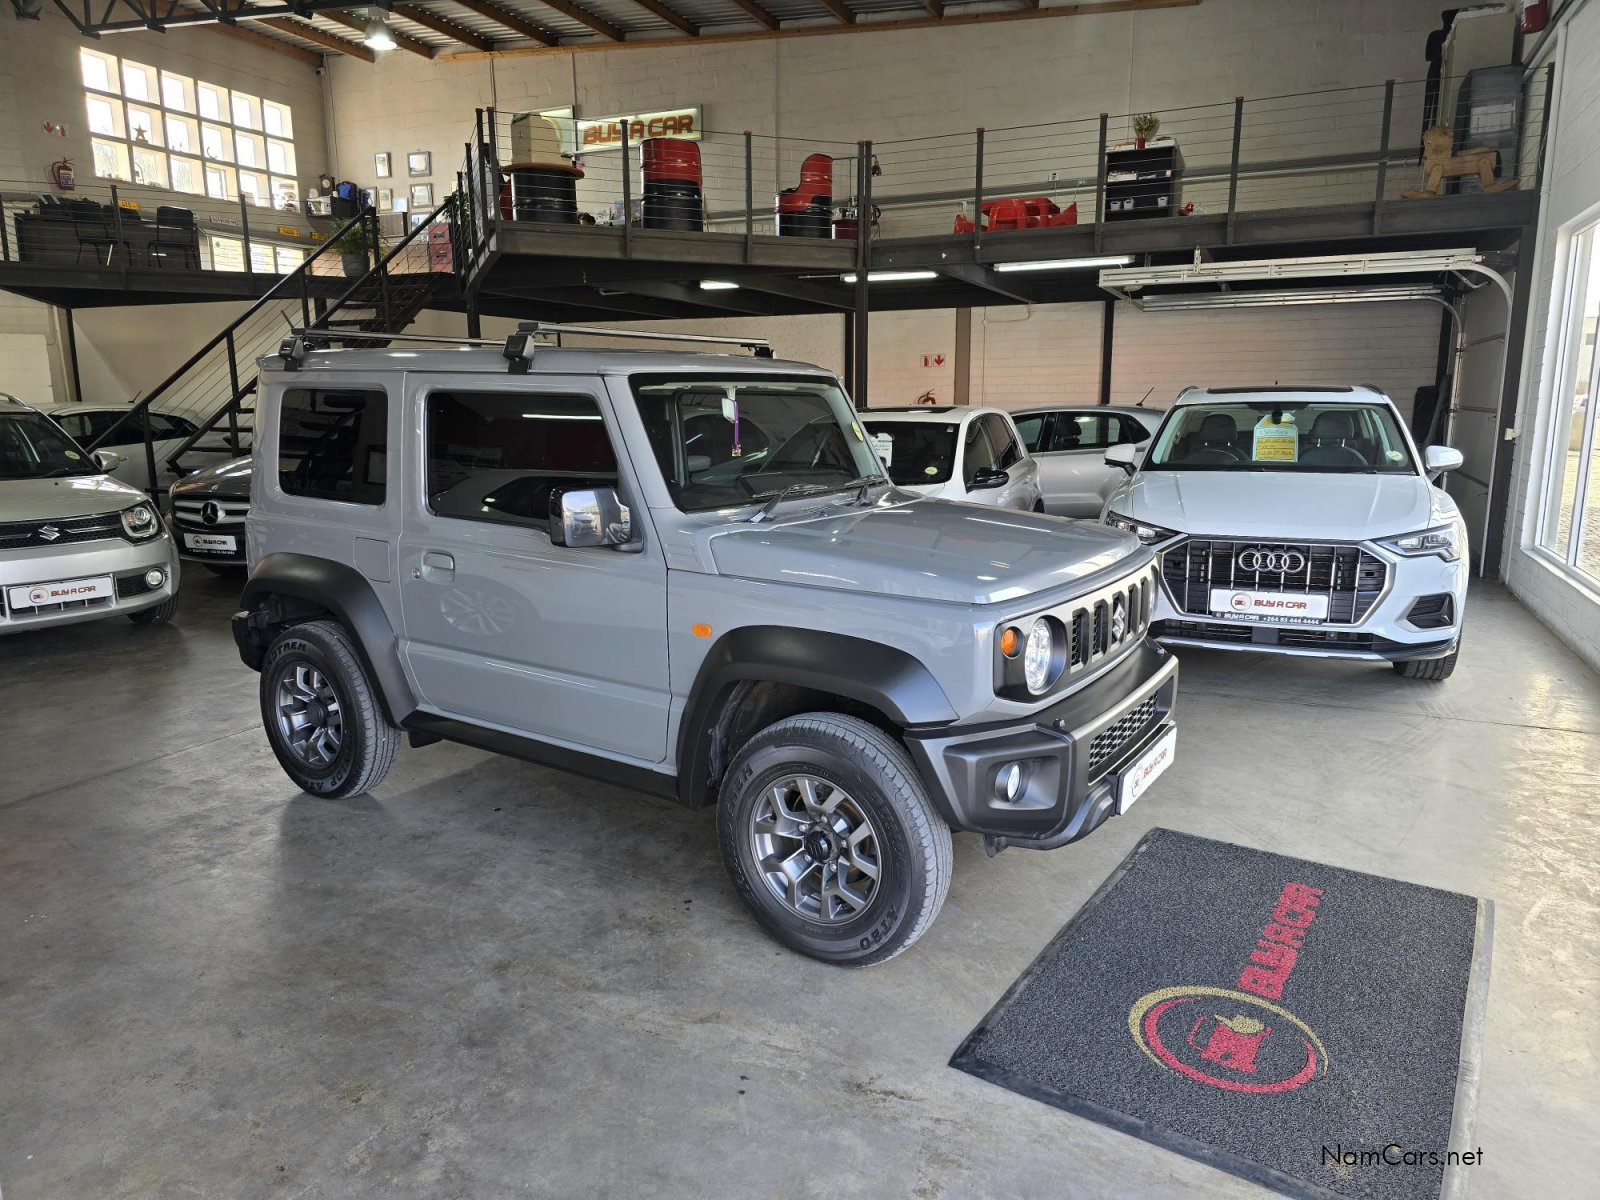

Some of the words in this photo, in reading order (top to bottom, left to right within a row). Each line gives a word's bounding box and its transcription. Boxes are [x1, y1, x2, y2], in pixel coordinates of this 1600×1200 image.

[583, 121, 623, 144] BUY
[629, 119, 645, 140] A
[647, 114, 694, 138] CAR
[51, 588, 70, 597] BUY
[78, 585, 96, 594] CAR
[1254, 599, 1276, 608] BUY
[1276, 600, 1284, 608] A
[1285, 601, 1307, 609] CAR
[1224, 612, 1239, 620] BUY
[1271, 882, 1326, 929] CAR
[1262, 922, 1305, 948] A
[1236, 939, 1298, 1000] BUY
